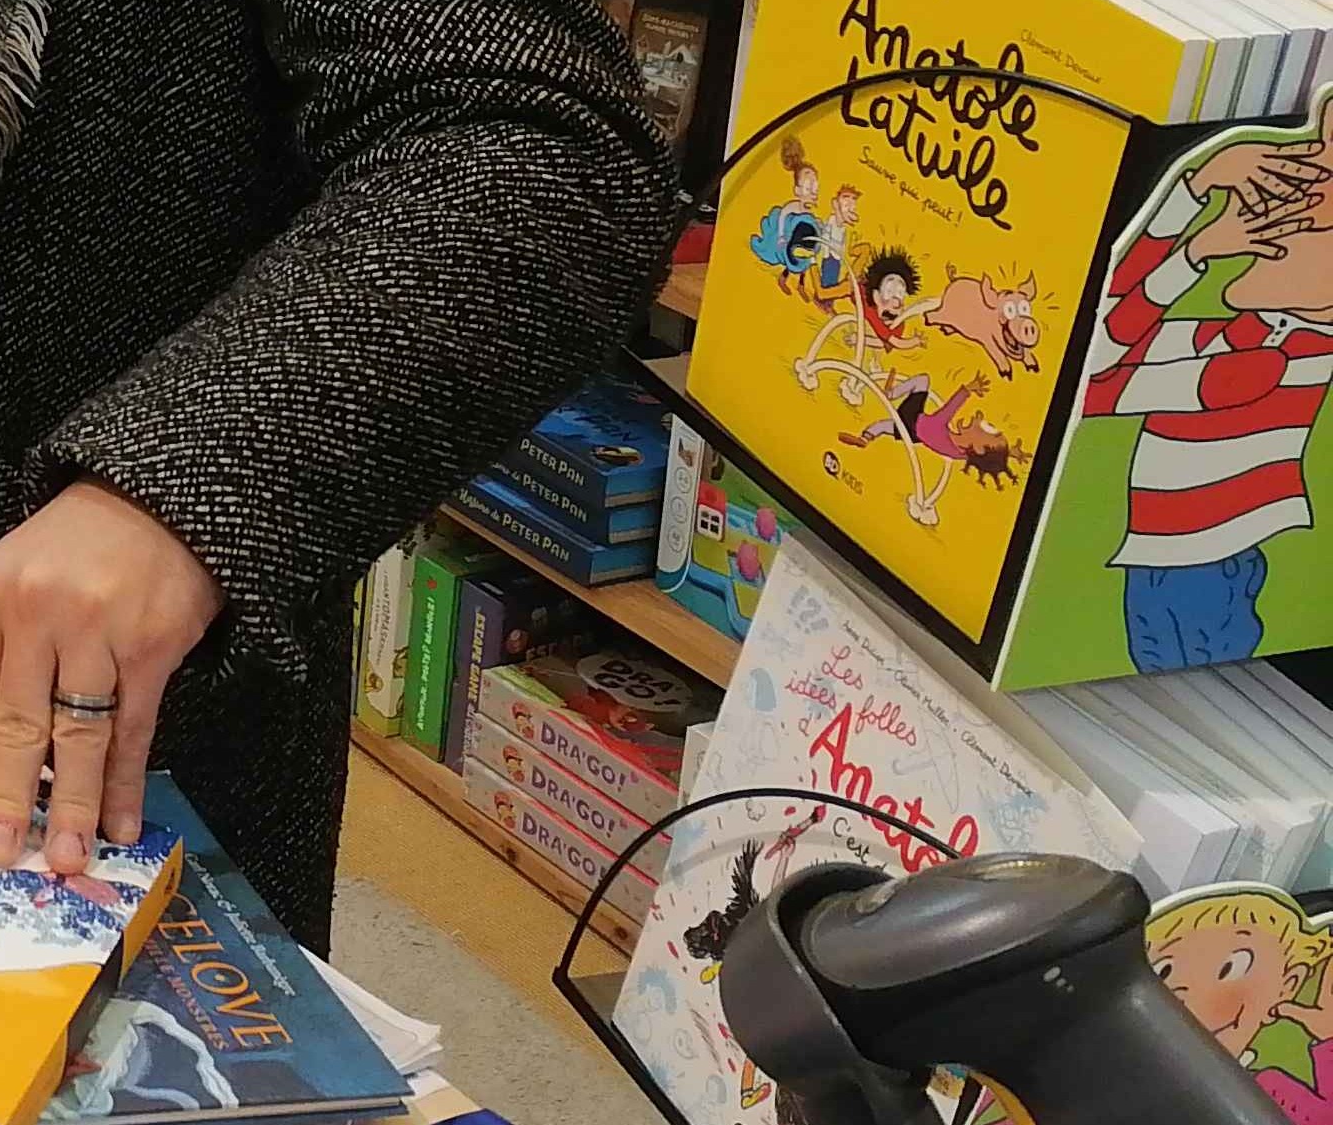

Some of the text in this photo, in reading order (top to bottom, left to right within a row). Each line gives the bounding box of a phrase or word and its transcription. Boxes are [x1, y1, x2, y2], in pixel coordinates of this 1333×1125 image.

[840, 56, 1012, 232] Latuile
[857, 145, 897, 186] Sauve
[520, 437, 586, 487] PETER PAN
[523, 473, 560, 513] PETER
[561, 493, 588, 525] PAN
[502, 510, 541, 548] PETER
[542, 534, 571, 565] PAN
[783, 671, 838, 712] idées
[820, 646, 865, 693] Les
[855, 695, 918, 749] folles
[539, 720, 628, 792] DRA'GO!
[530, 768, 616, 839] DRA'GO!
[809, 702, 979, 874] Anatol
[832, 817, 872, 864] C'est
